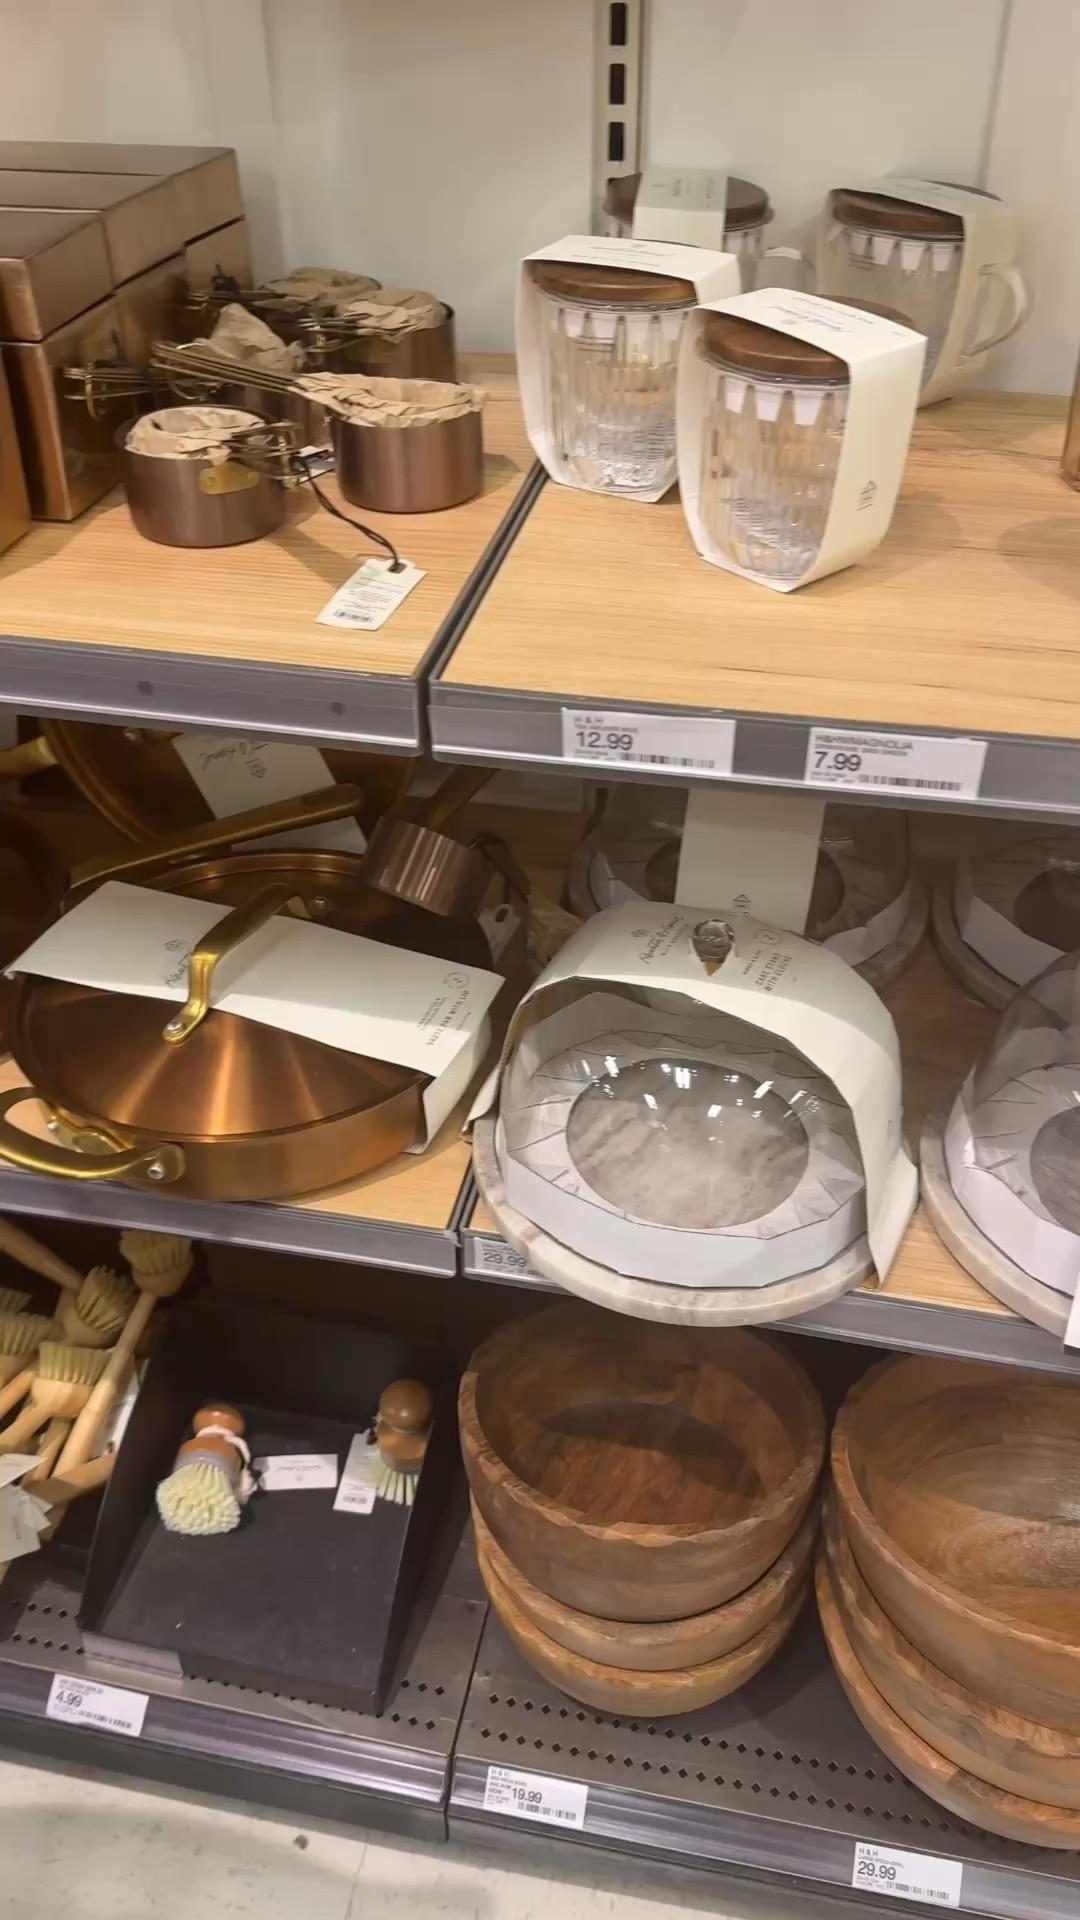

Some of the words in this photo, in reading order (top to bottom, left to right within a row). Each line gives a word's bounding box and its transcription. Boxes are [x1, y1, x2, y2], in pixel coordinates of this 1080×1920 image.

[576, 731, 633, 751] 12.99
[815, 751, 861, 771] 7.99
[448, 1001, 464, 1014] WITH
[483, 1252, 527, 1268] 29.99
[56, 1691, 83, 1707] 4.99
[512, 1787, 542, 1803] 19.99
[858, 1861, 896, 1880] 29.99
